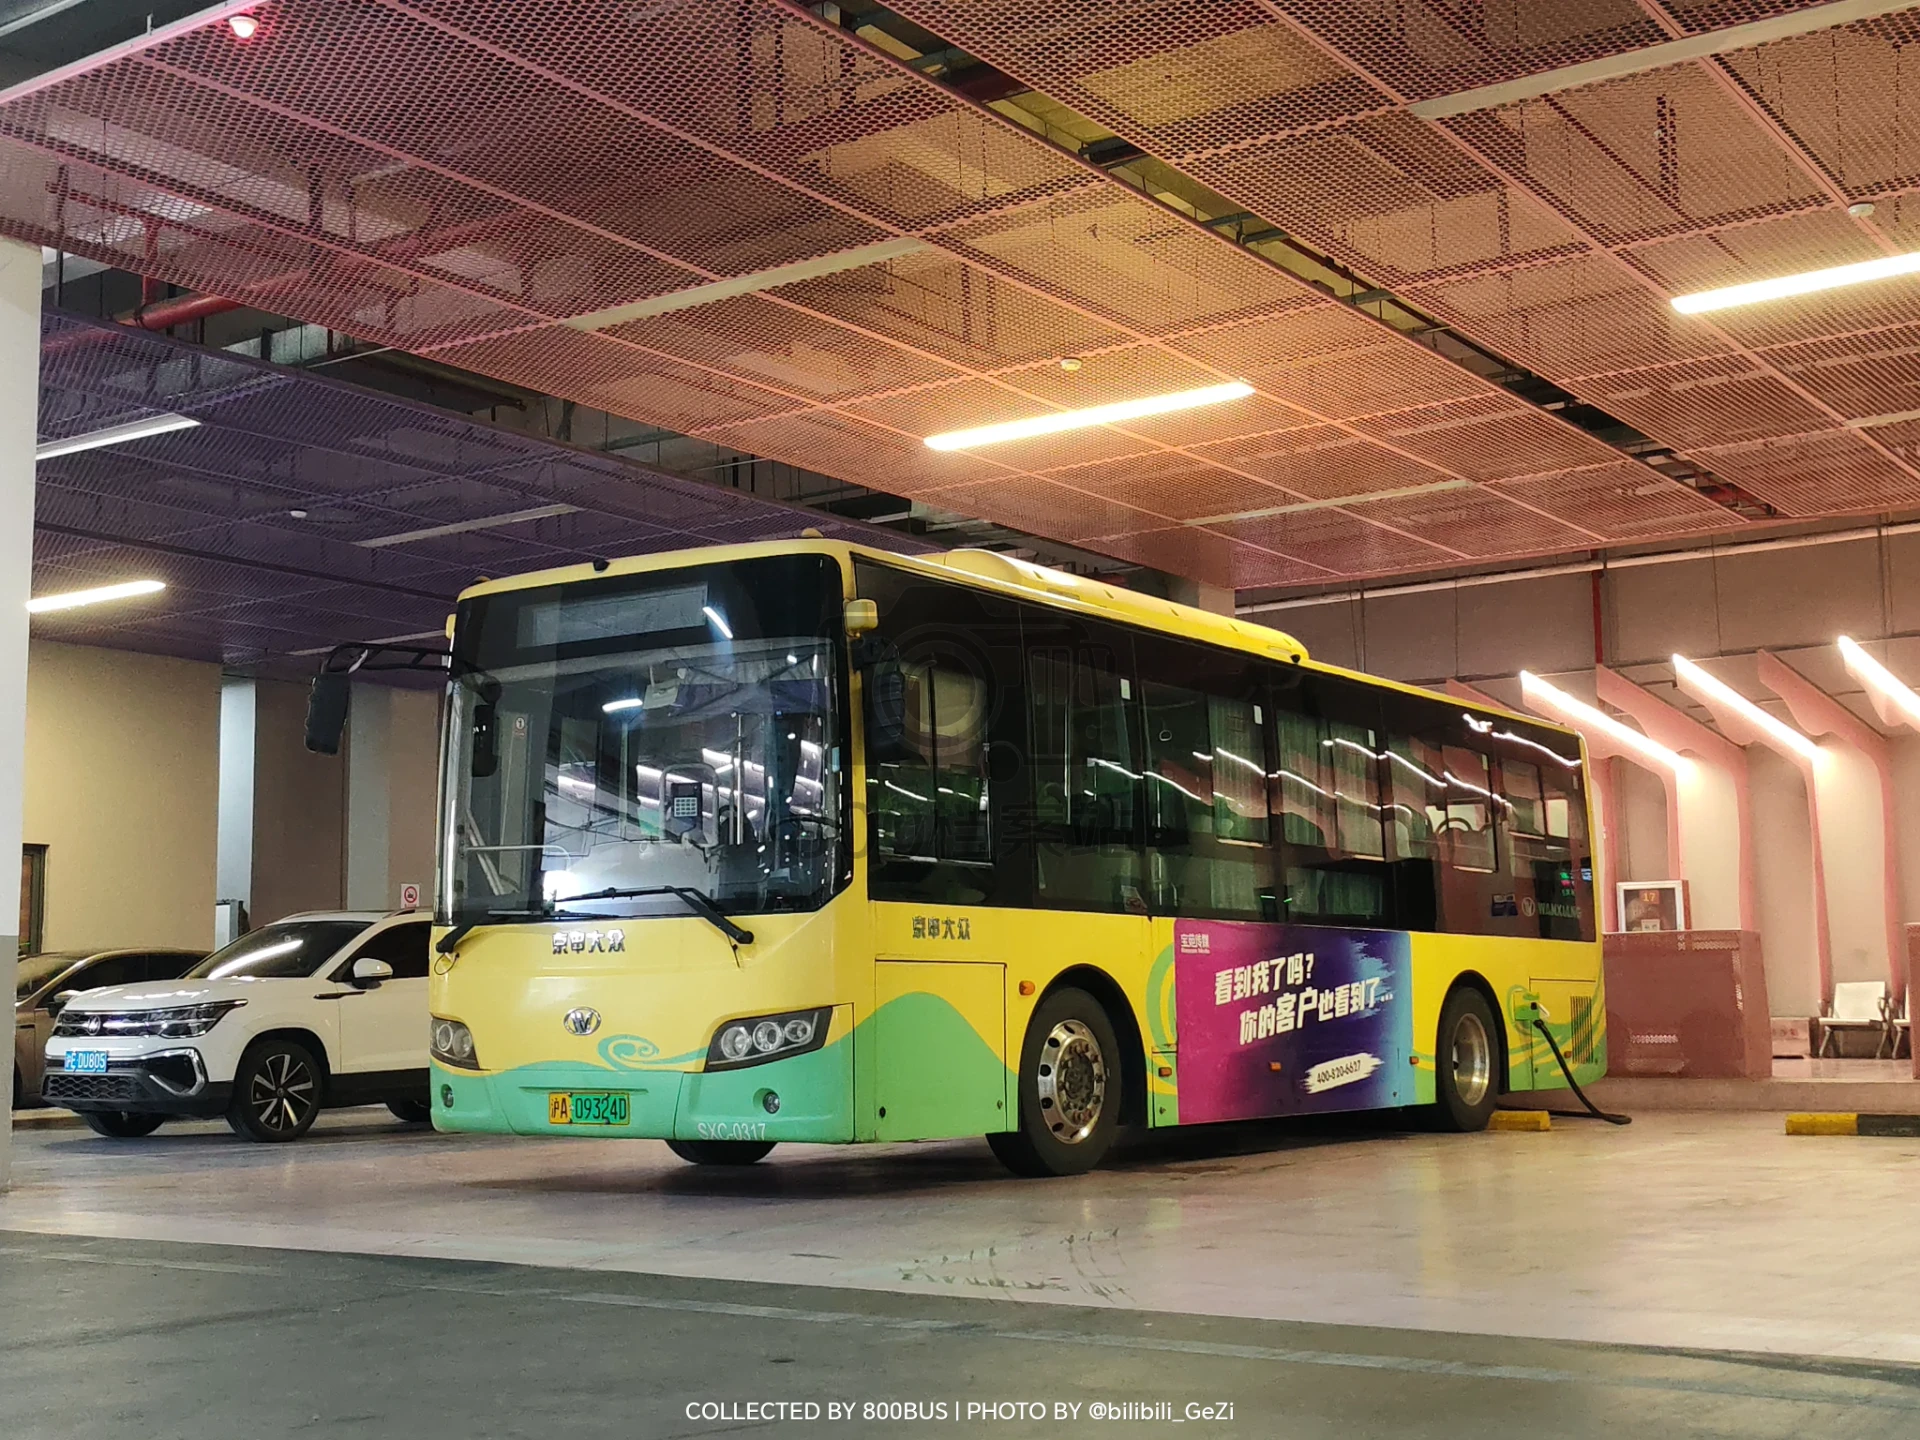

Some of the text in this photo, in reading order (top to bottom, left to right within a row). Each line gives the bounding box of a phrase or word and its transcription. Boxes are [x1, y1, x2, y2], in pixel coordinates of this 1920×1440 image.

[1643, 892, 1656, 903] 17
[1214, 953, 1314, 1005] 看到我了吗?
[697, 1122, 766, 1141] SXC-0317
